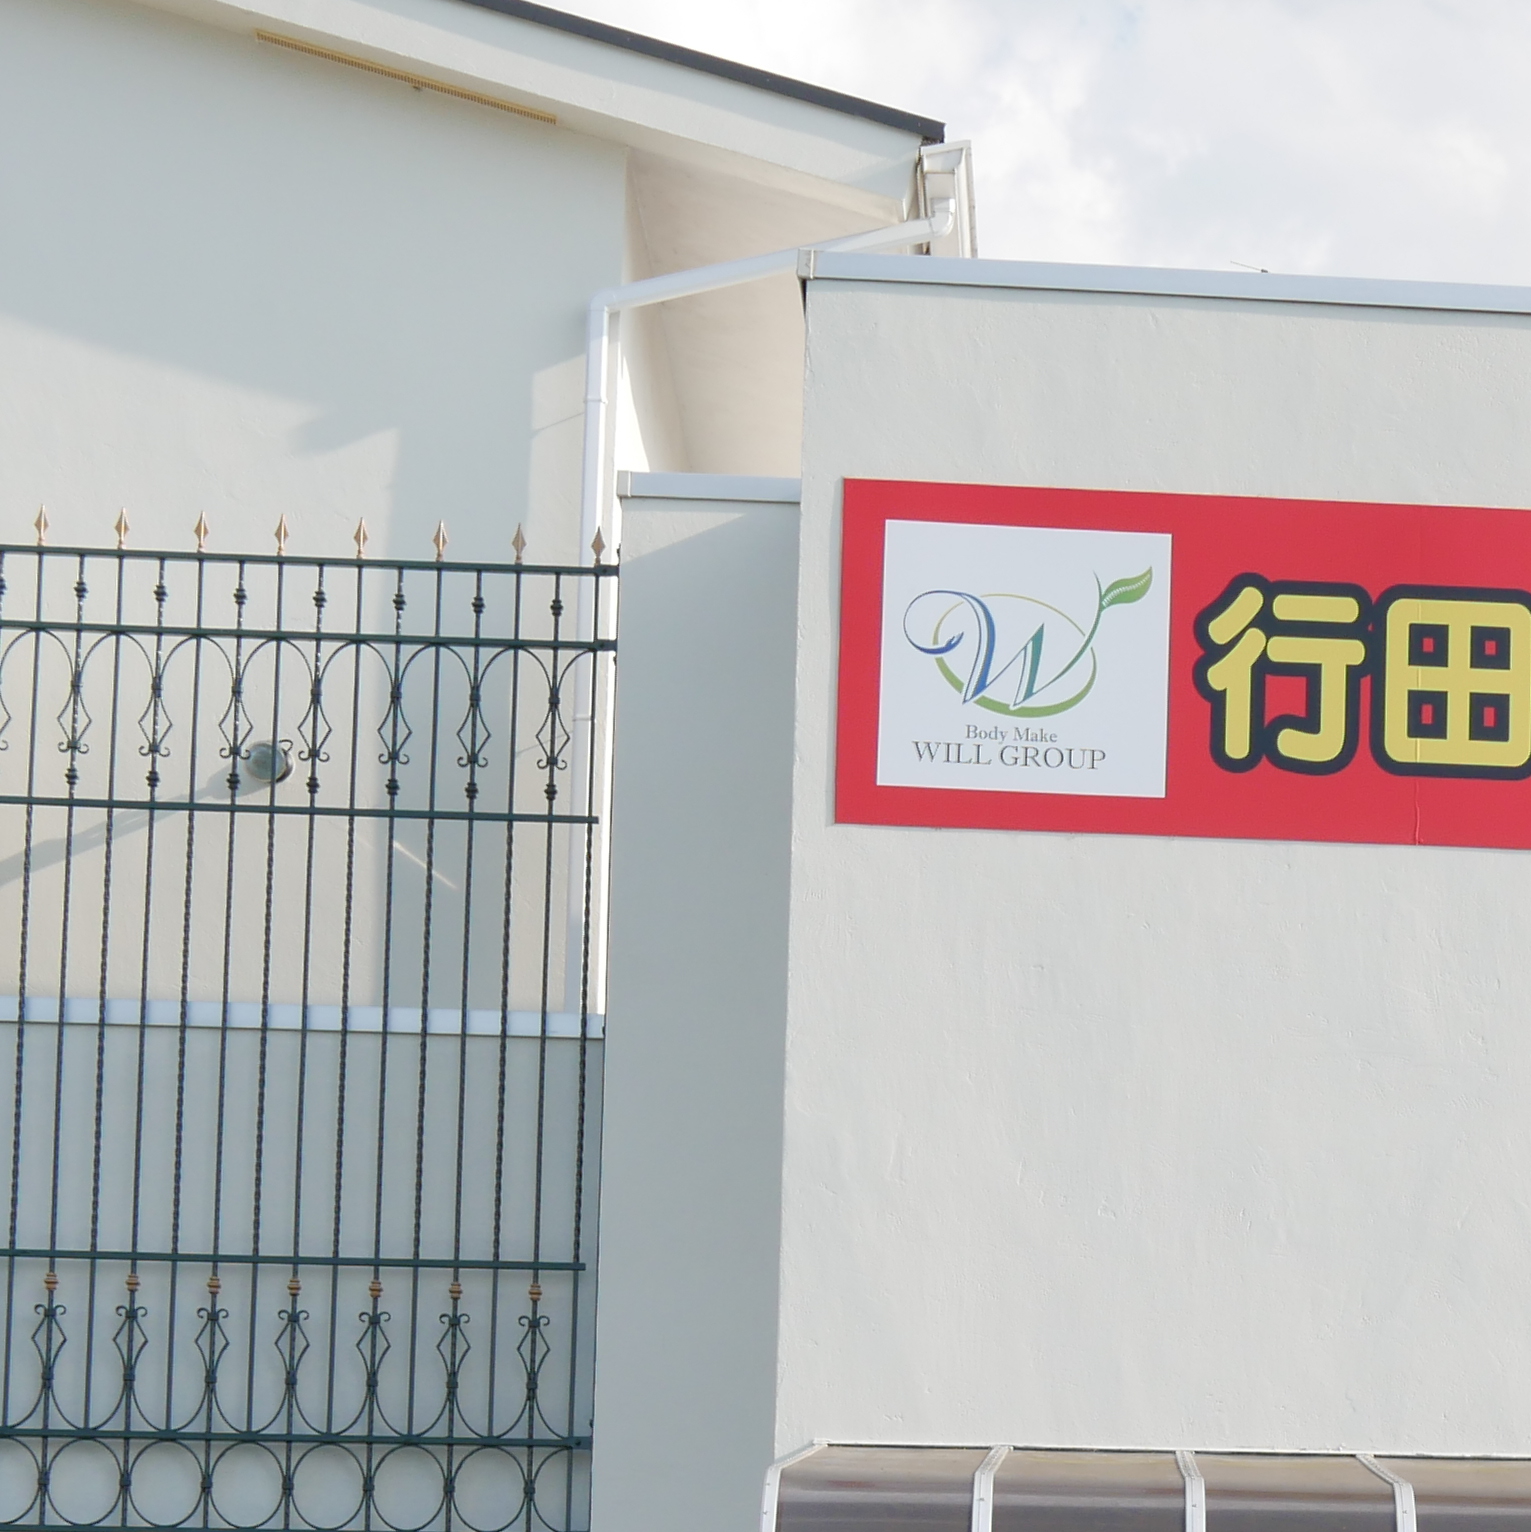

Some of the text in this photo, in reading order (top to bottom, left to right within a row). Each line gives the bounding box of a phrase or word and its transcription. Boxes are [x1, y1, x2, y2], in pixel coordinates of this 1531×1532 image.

[965, 724, 1058, 744] Body Make
[912, 740, 1106, 770] WILL GROUP
